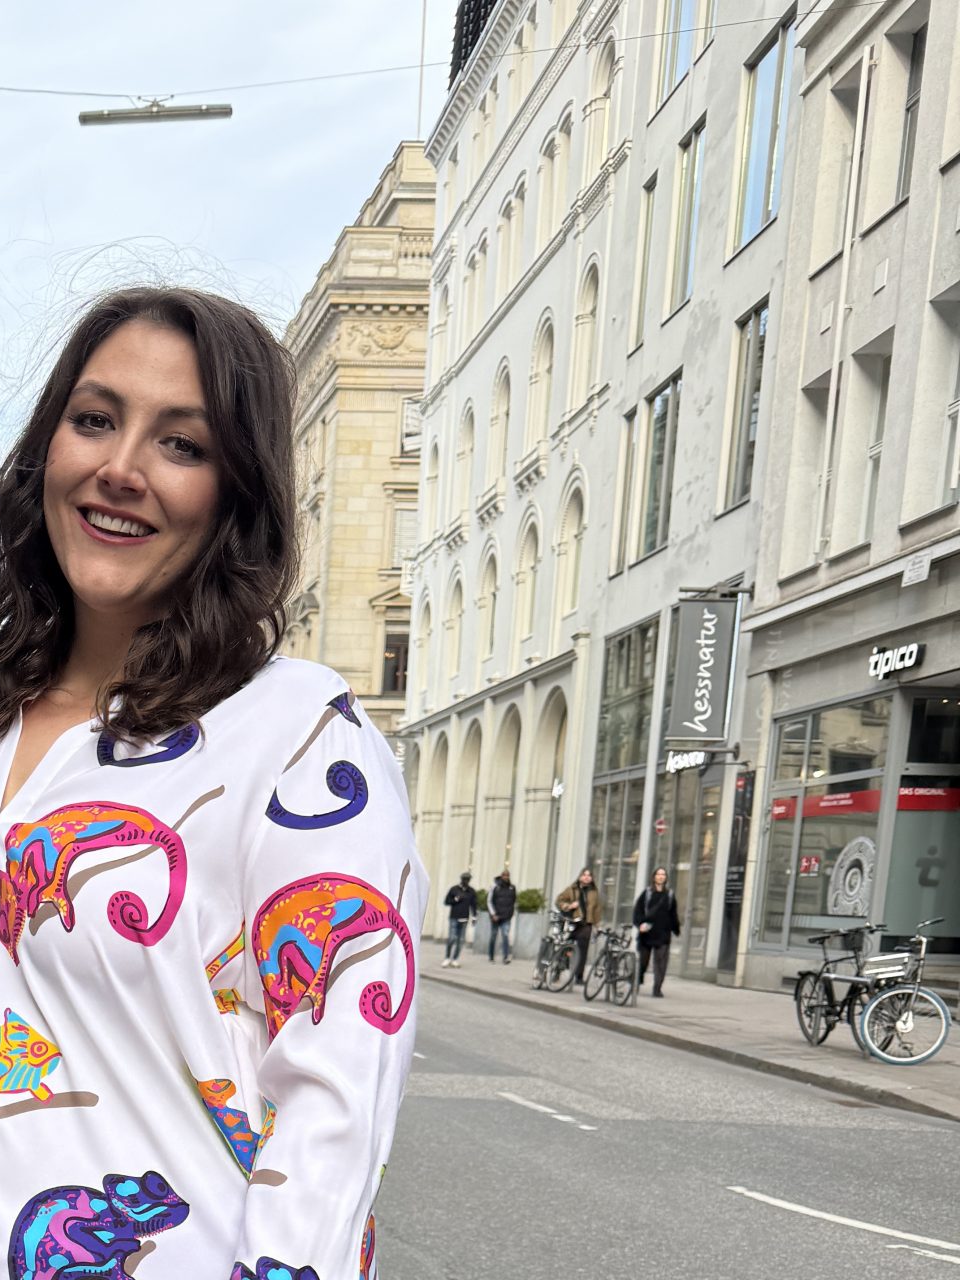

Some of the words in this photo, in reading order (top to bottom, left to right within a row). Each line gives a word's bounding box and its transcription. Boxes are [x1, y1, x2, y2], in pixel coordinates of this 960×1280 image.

[682, 607, 719, 733] hessnatur
[868, 642, 919, 680] tipico
[899, 787, 914, 796] DAS
